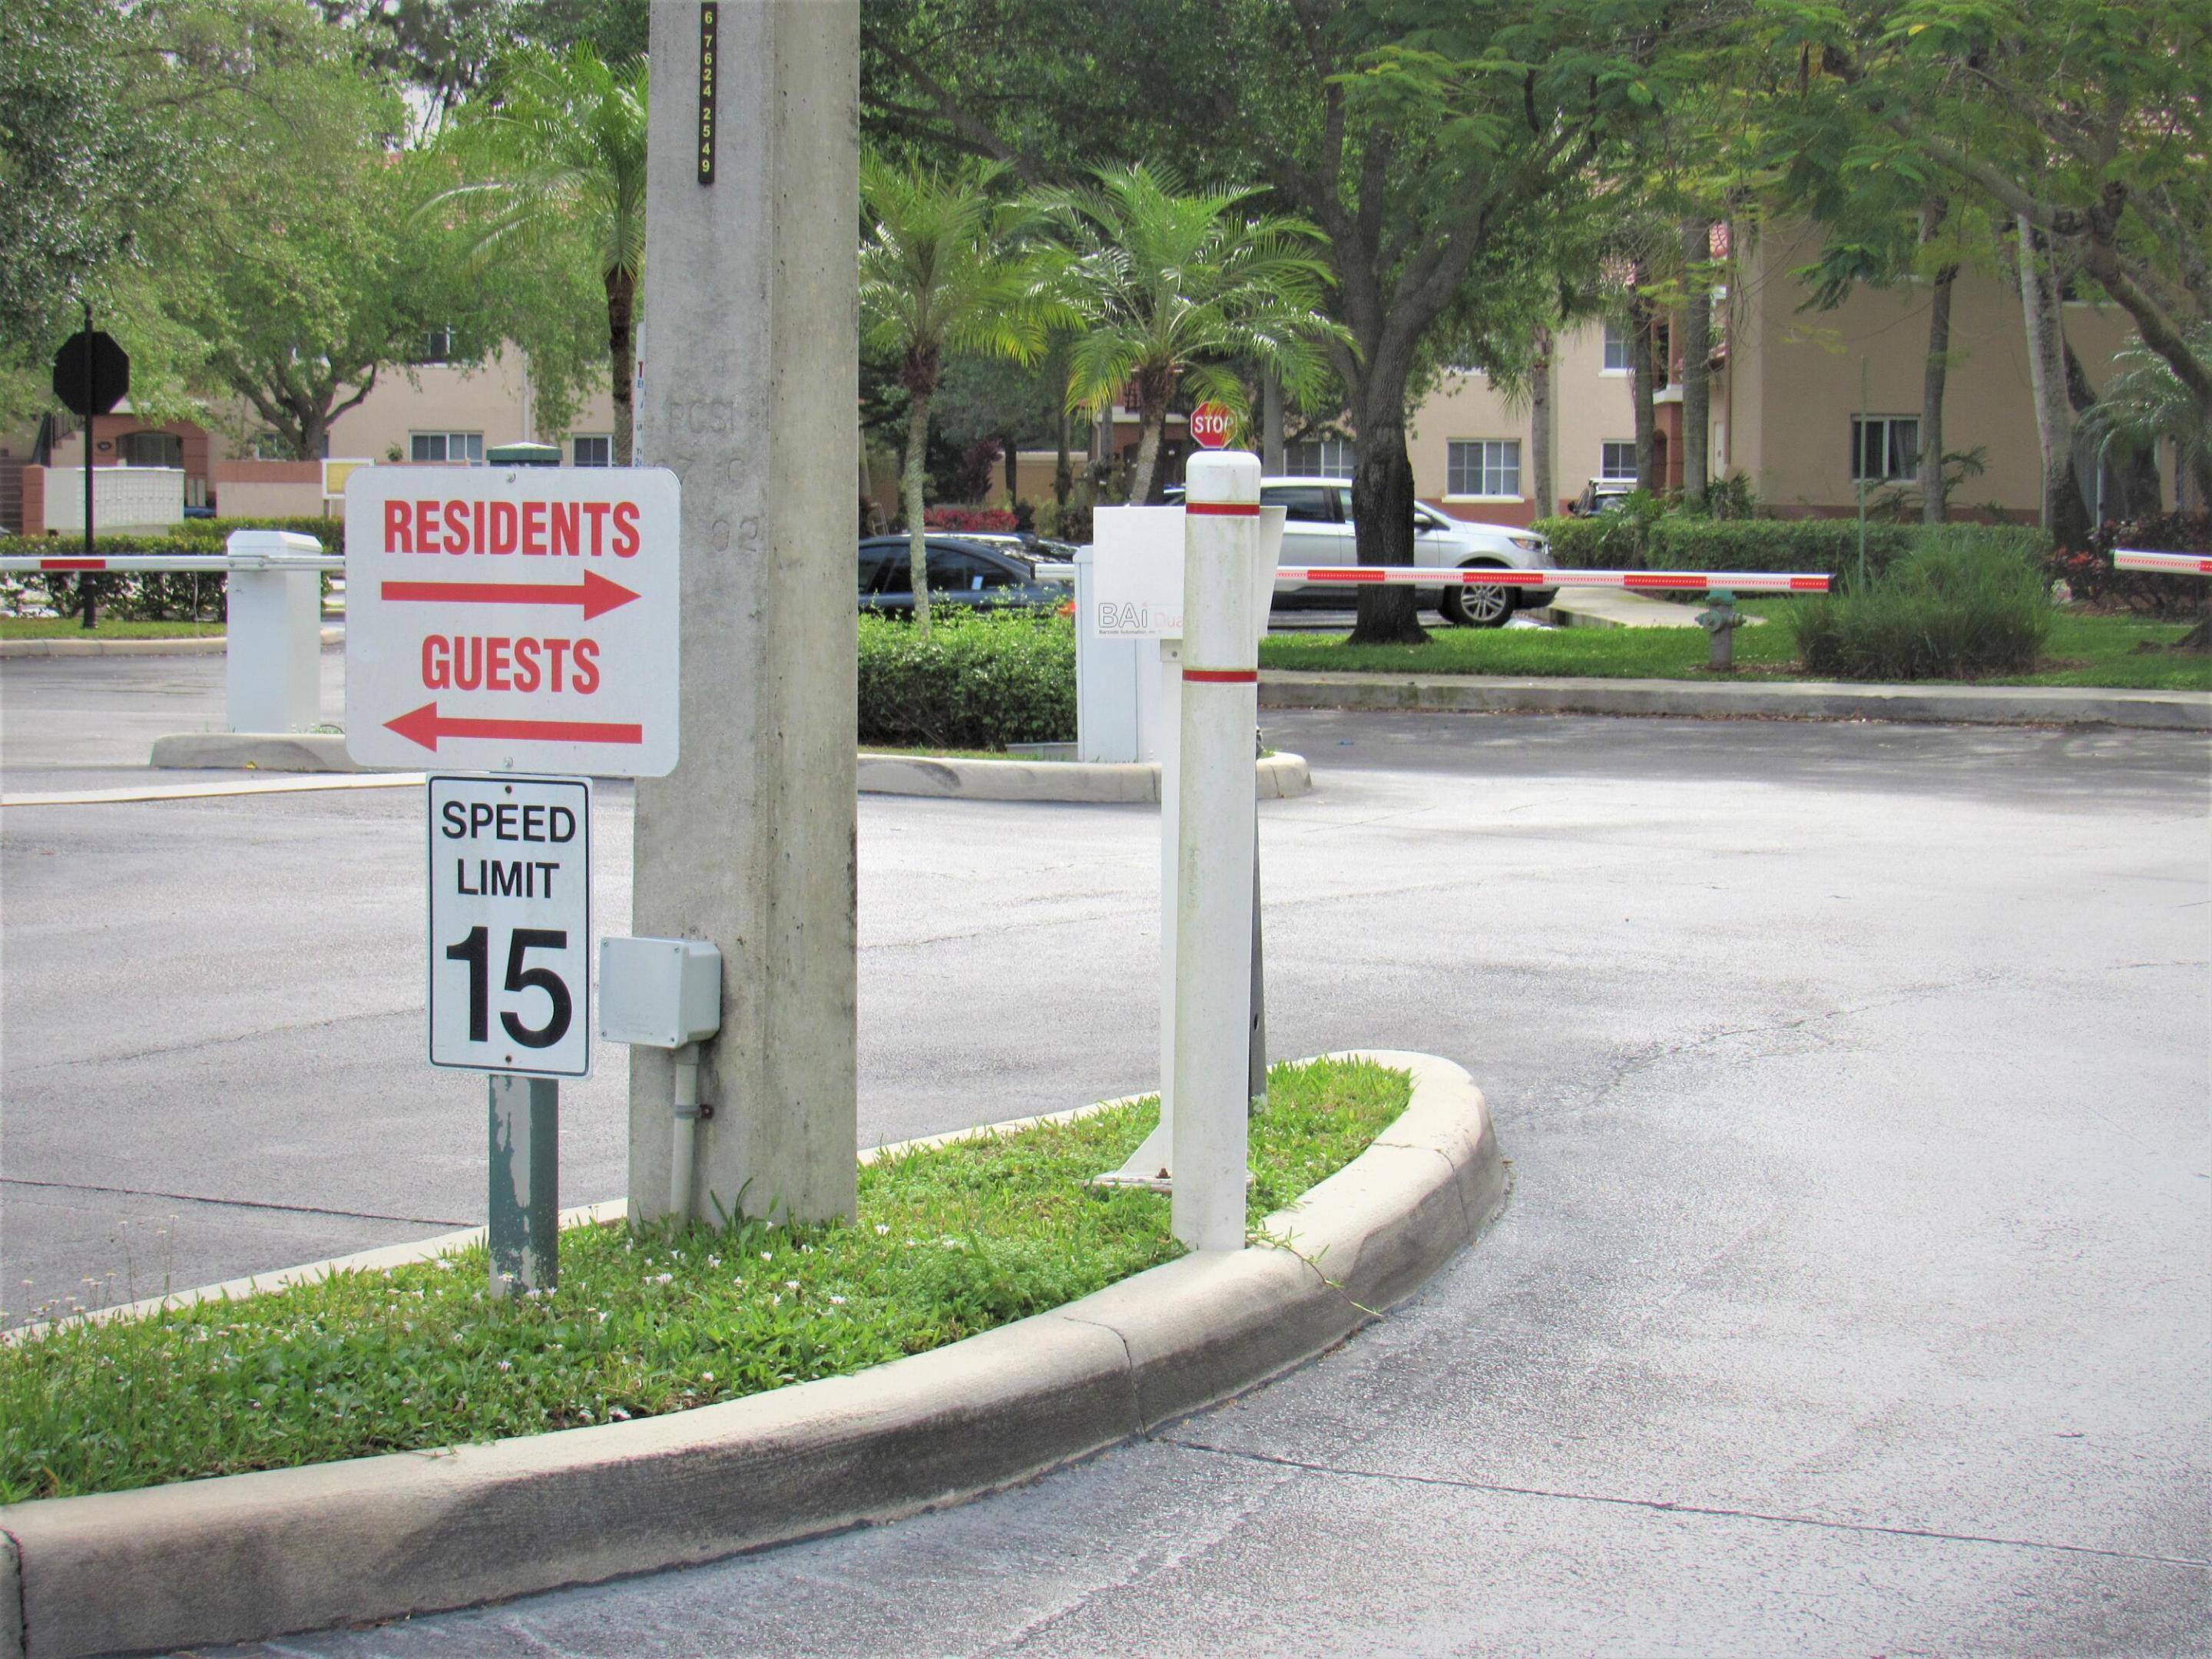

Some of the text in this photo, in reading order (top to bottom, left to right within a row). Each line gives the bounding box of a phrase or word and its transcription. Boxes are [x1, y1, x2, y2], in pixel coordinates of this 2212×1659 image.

[1194, 416, 1234, 433] STOP
[385, 500, 641, 558] RESIDENTS
[422, 634, 600, 694] GUESTS
[442, 801, 576, 843] SPEED
[458, 859, 560, 899] LIMIT
[446, 926, 572, 1048] 15
